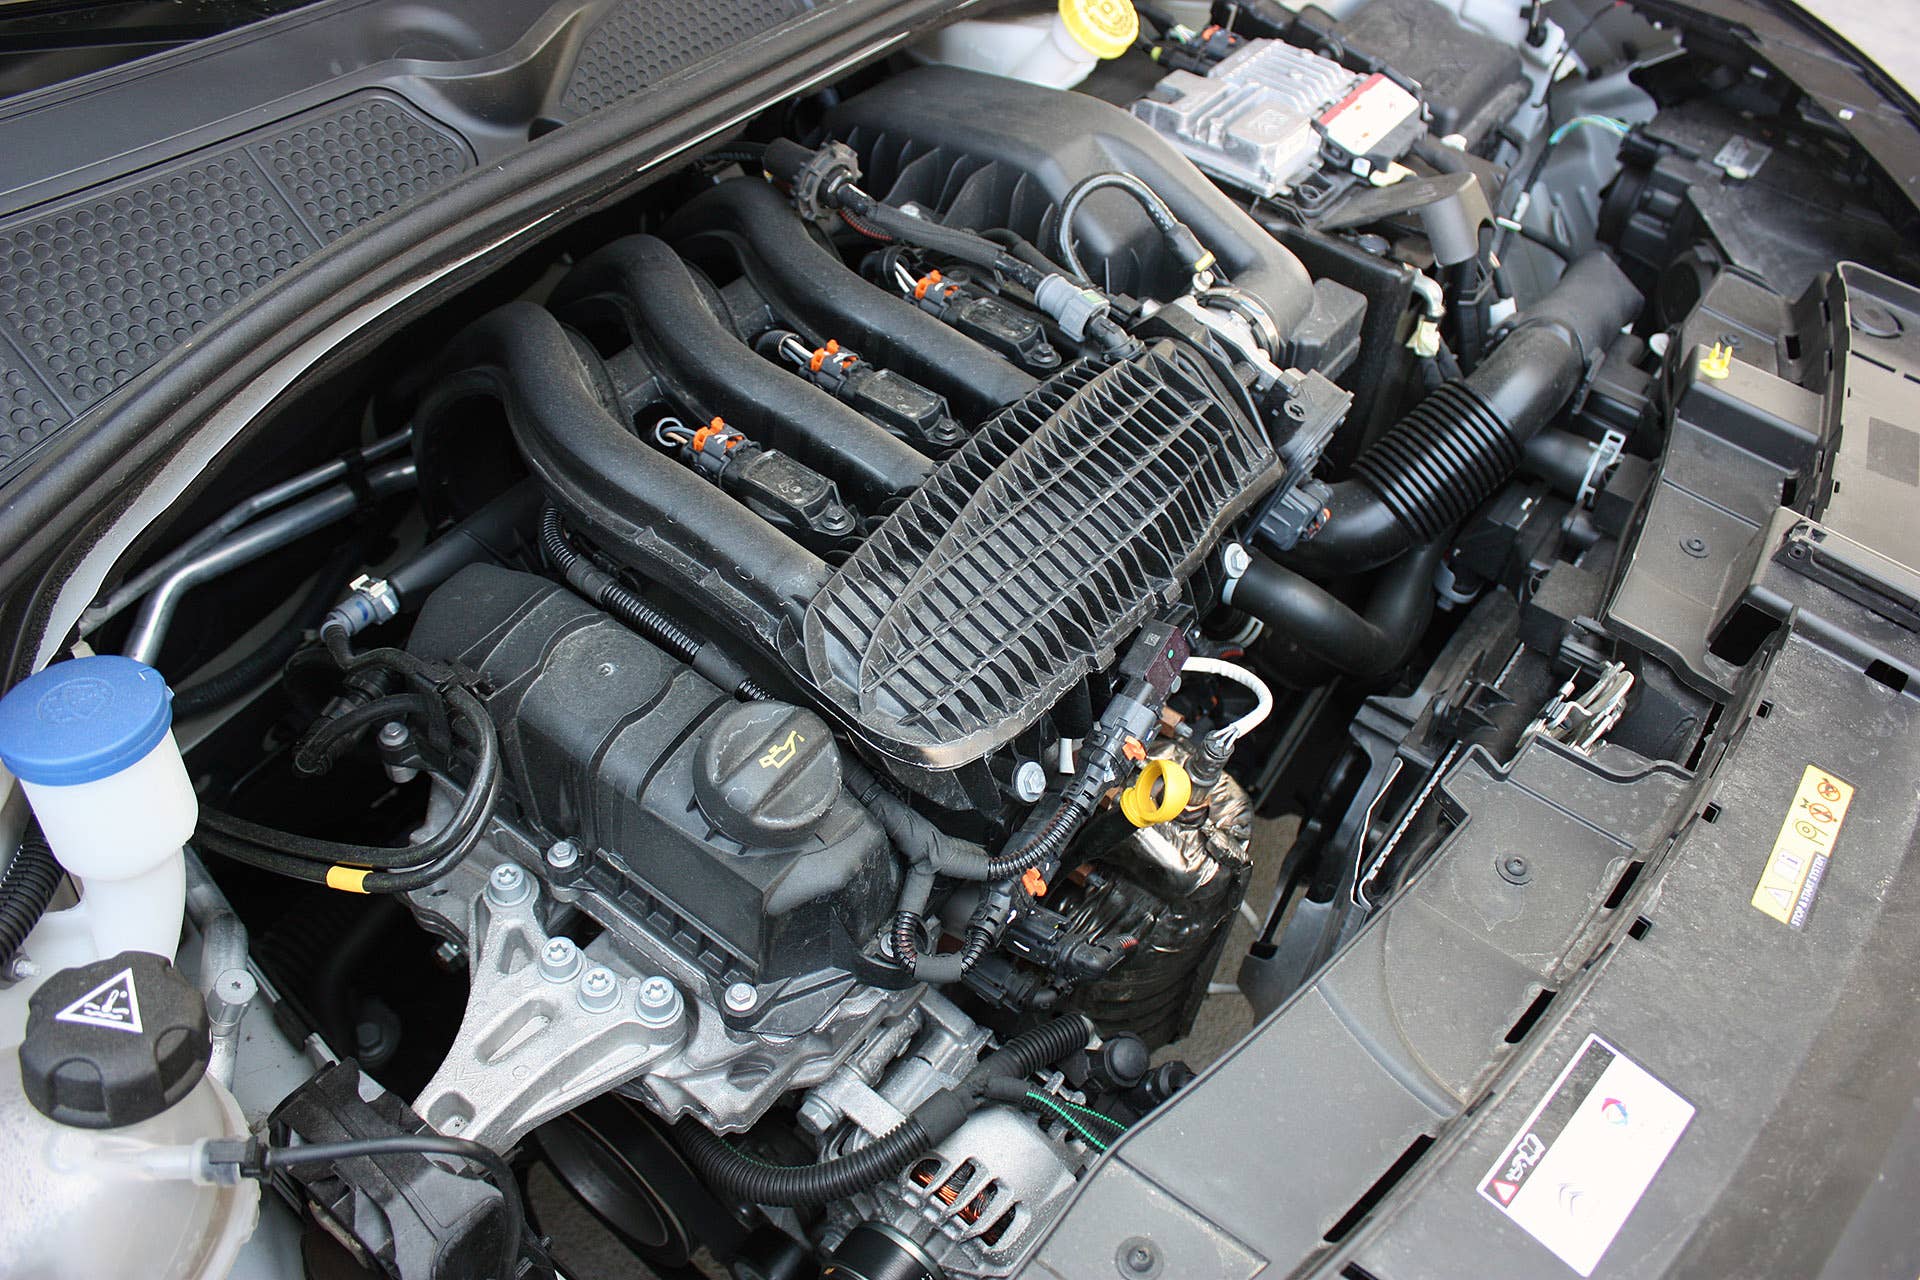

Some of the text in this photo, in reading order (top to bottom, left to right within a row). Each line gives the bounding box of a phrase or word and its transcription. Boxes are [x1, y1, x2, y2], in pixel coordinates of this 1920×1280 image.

[1790, 905, 1807, 927] STOP
[1799, 878, 1816, 903] START
[1808, 854, 1826, 881] SYSTEM
